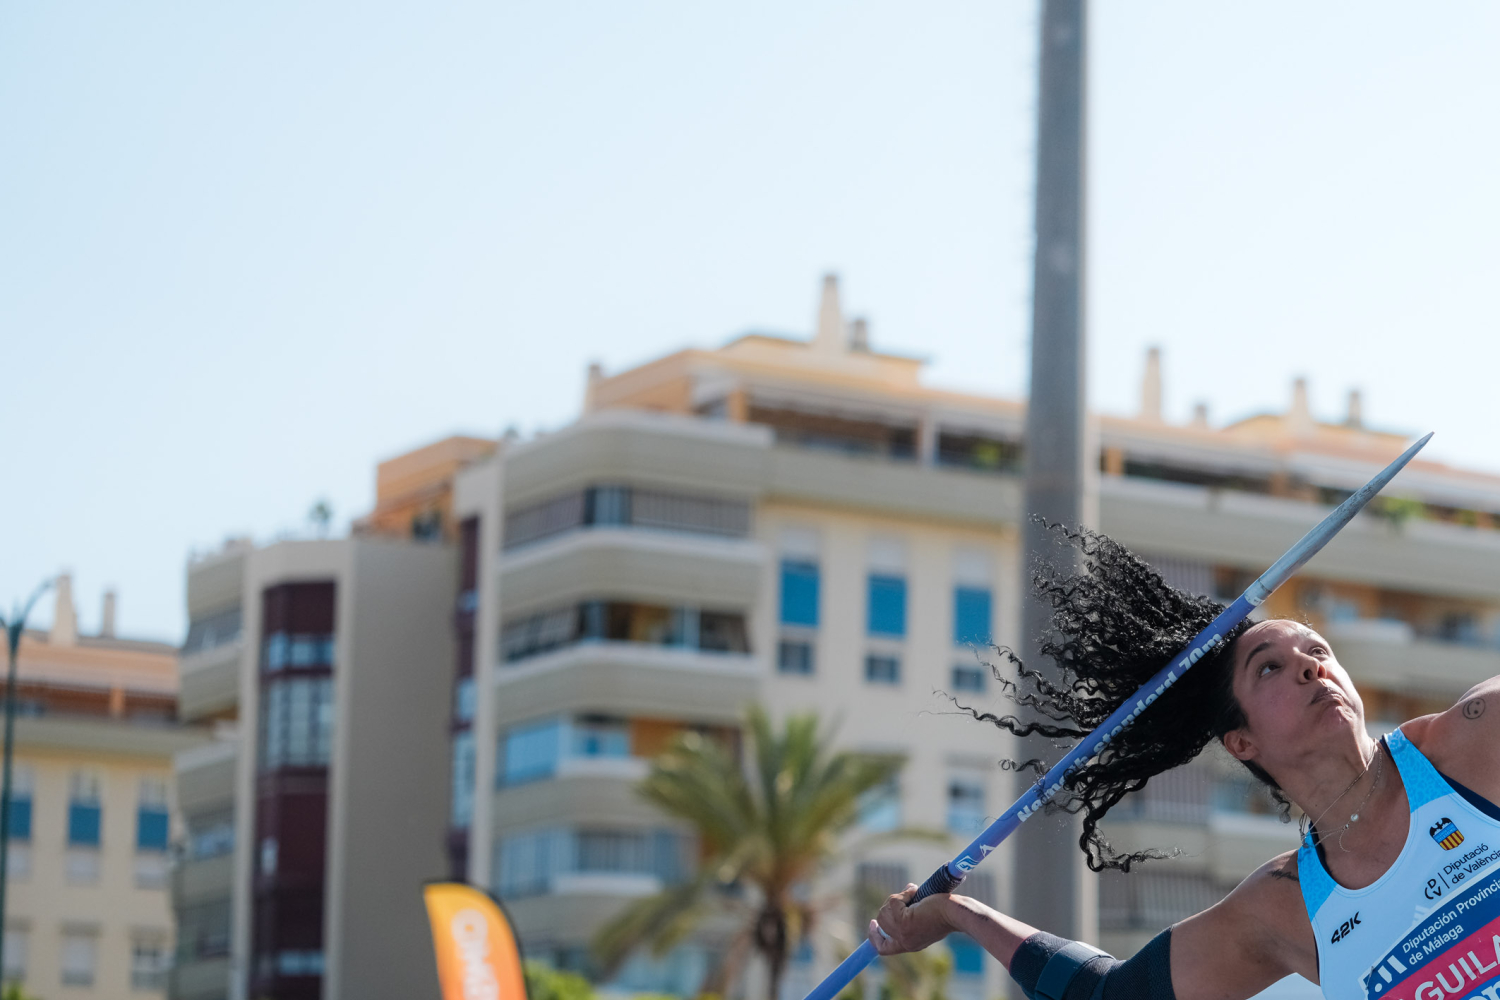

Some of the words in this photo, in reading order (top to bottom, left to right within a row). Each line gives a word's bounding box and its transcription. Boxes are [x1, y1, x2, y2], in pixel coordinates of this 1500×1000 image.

[1178, 632, 1223, 671] 70m
[1443, 843, 1489, 875] Diputació
[1451, 872, 1465, 884] de
[1331, 911, 1362, 944] 42K
[1402, 911, 1458, 953] Diputación
[1408, 951, 1424, 965] de
[1422, 924, 1464, 955] Málaga
